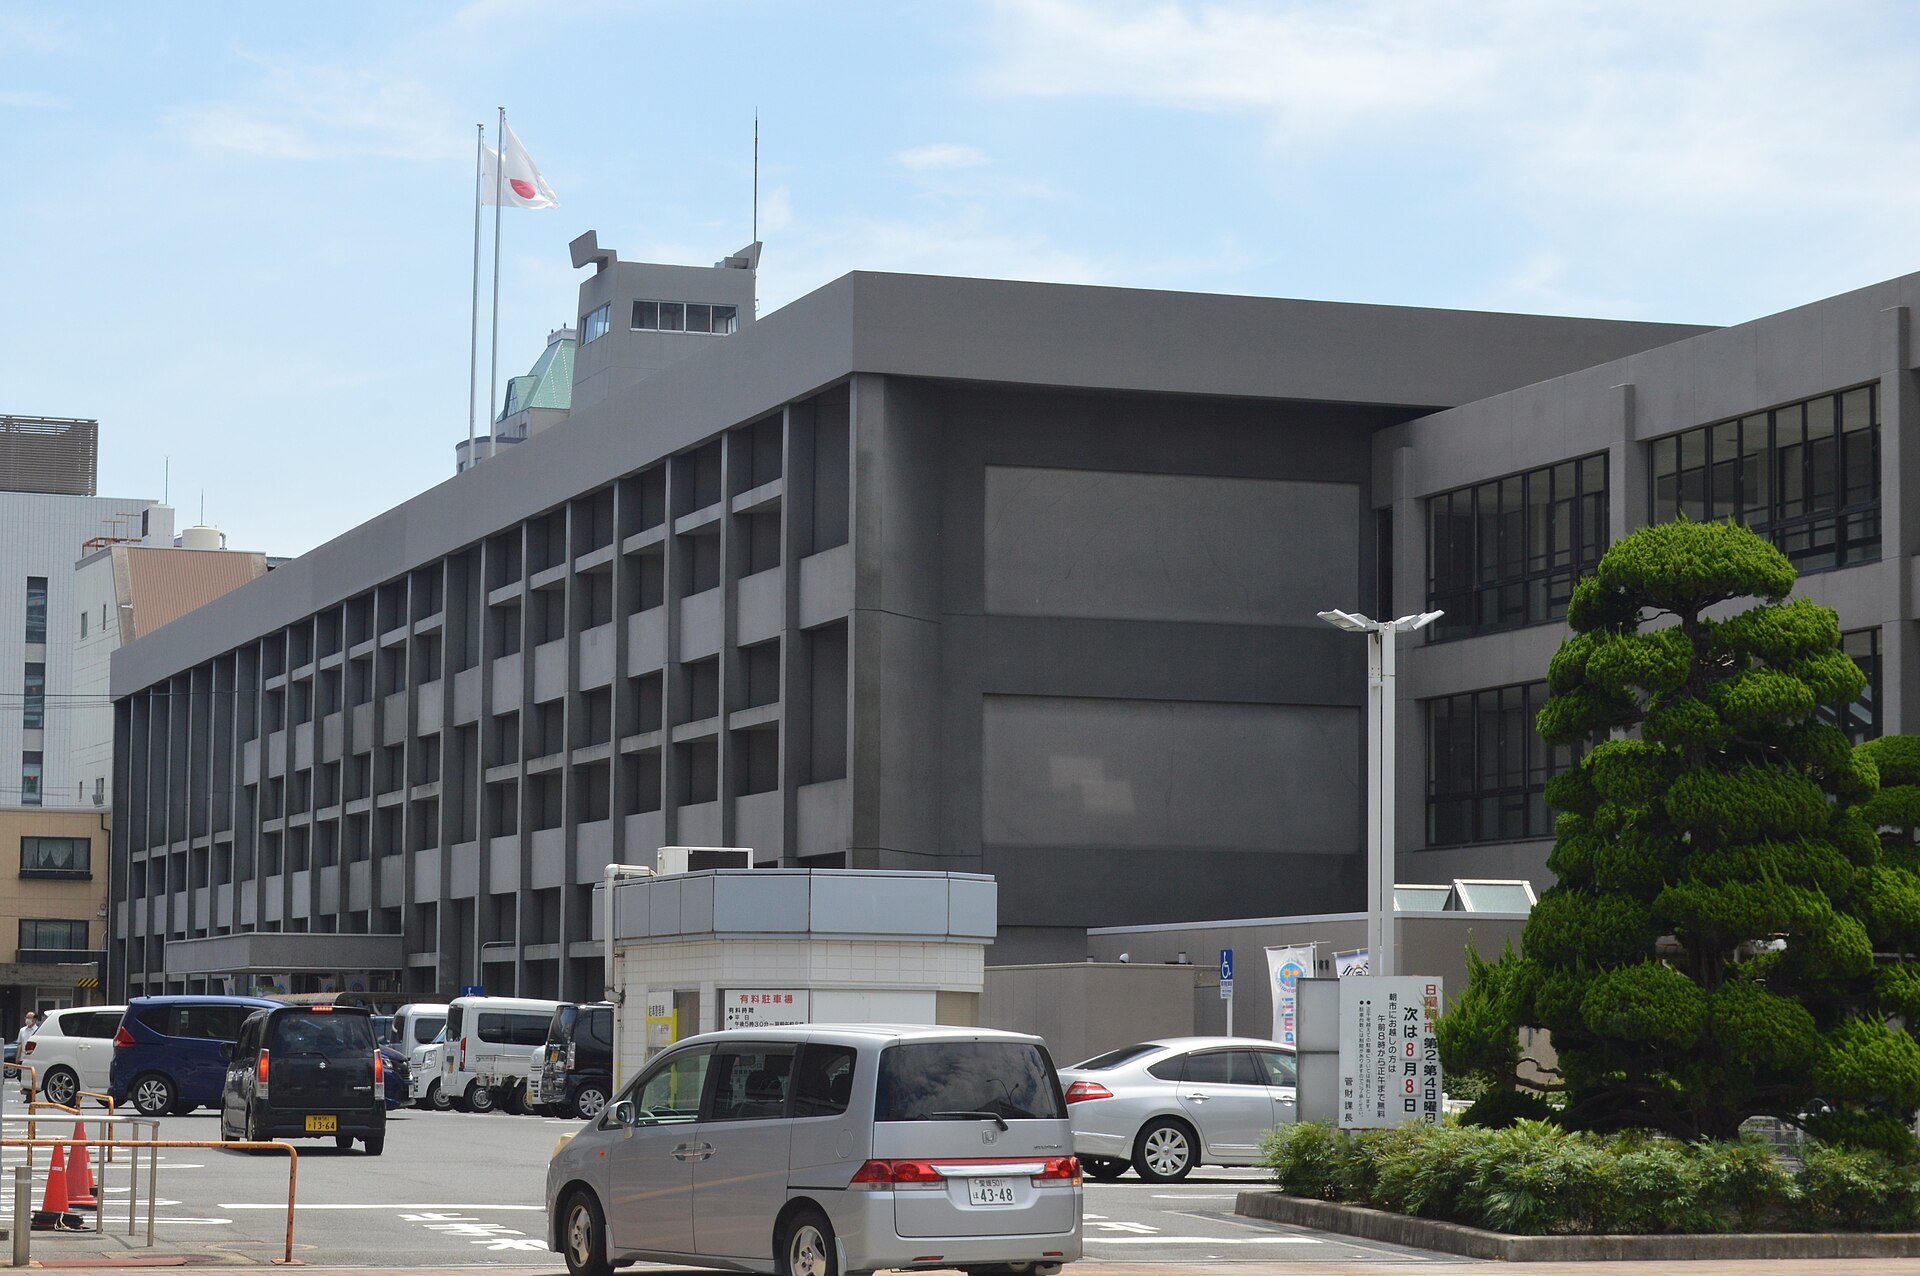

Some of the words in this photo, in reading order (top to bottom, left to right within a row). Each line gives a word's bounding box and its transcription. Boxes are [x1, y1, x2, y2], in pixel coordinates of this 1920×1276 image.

[740, 994, 793, 1004] 有料駐車場
[1377, 1014, 1386, 1118] 午前8時から正午まで無料
[1403, 1007, 1418, 1113] 次は8月8日
[1344, 1077, 1353, 1123] 管財課長
[981, 1188, 1013, 1202] 43-48
